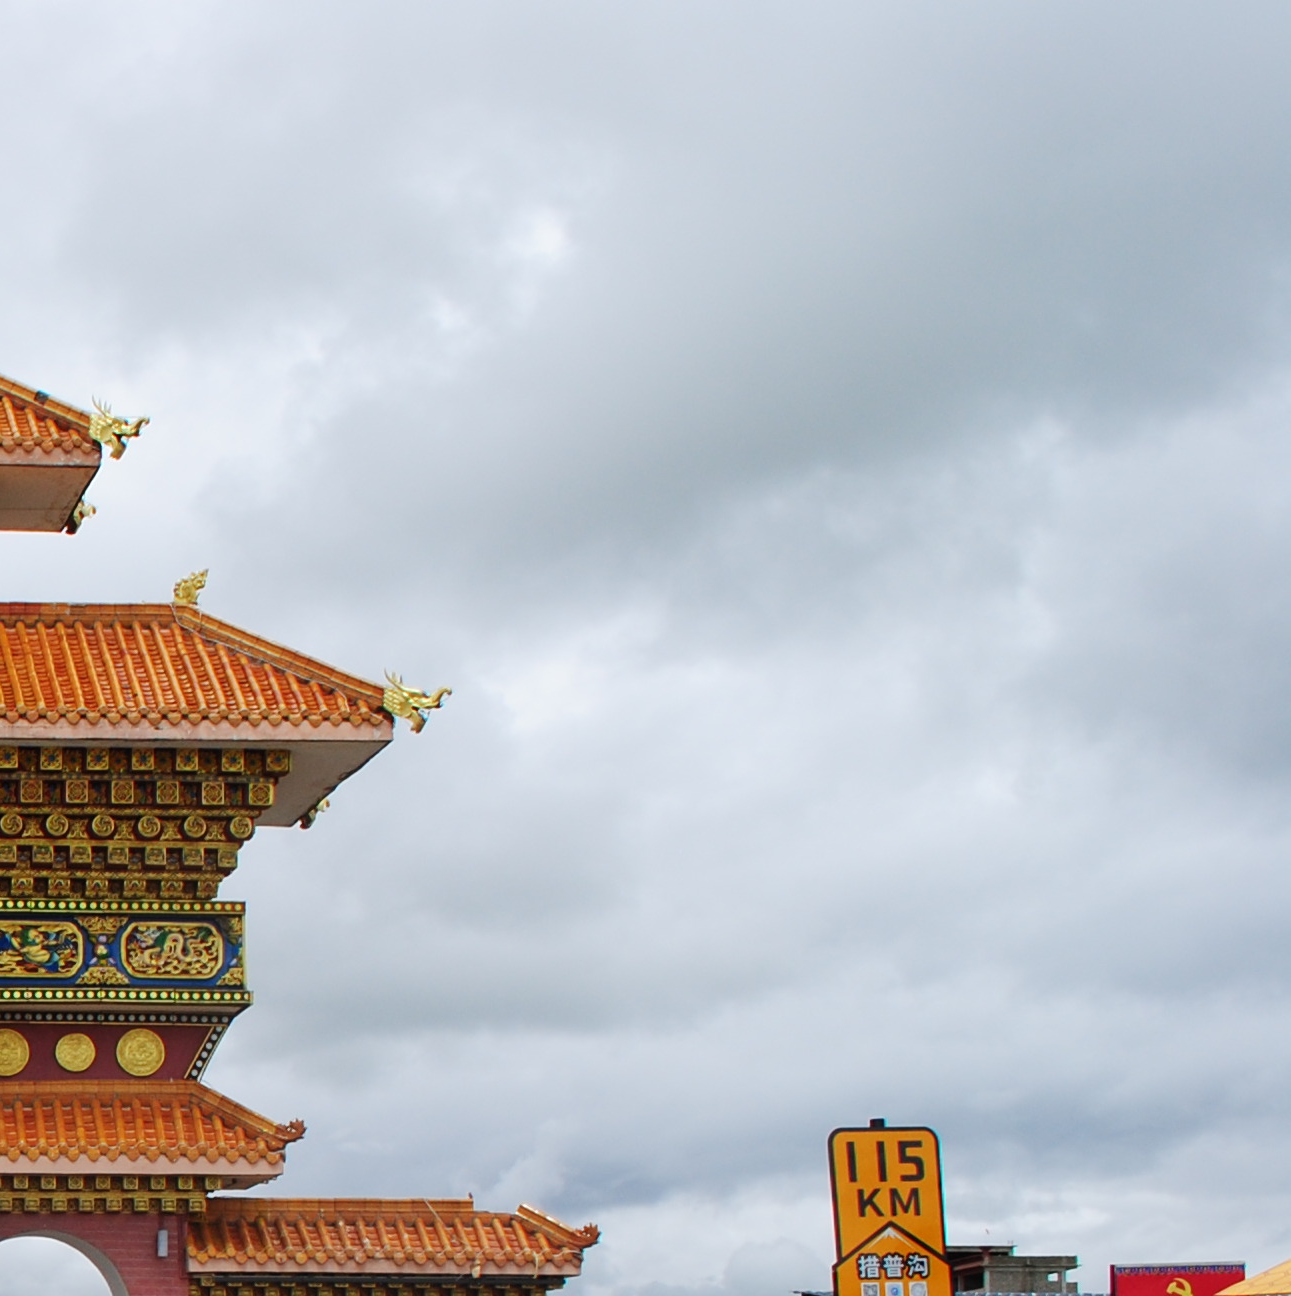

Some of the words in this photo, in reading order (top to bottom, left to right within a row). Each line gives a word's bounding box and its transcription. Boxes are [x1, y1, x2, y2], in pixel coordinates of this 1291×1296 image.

[845, 1140, 926, 1184] 115
[857, 1188, 922, 1218] KM
[857, 1253, 930, 1280] 措普沟
